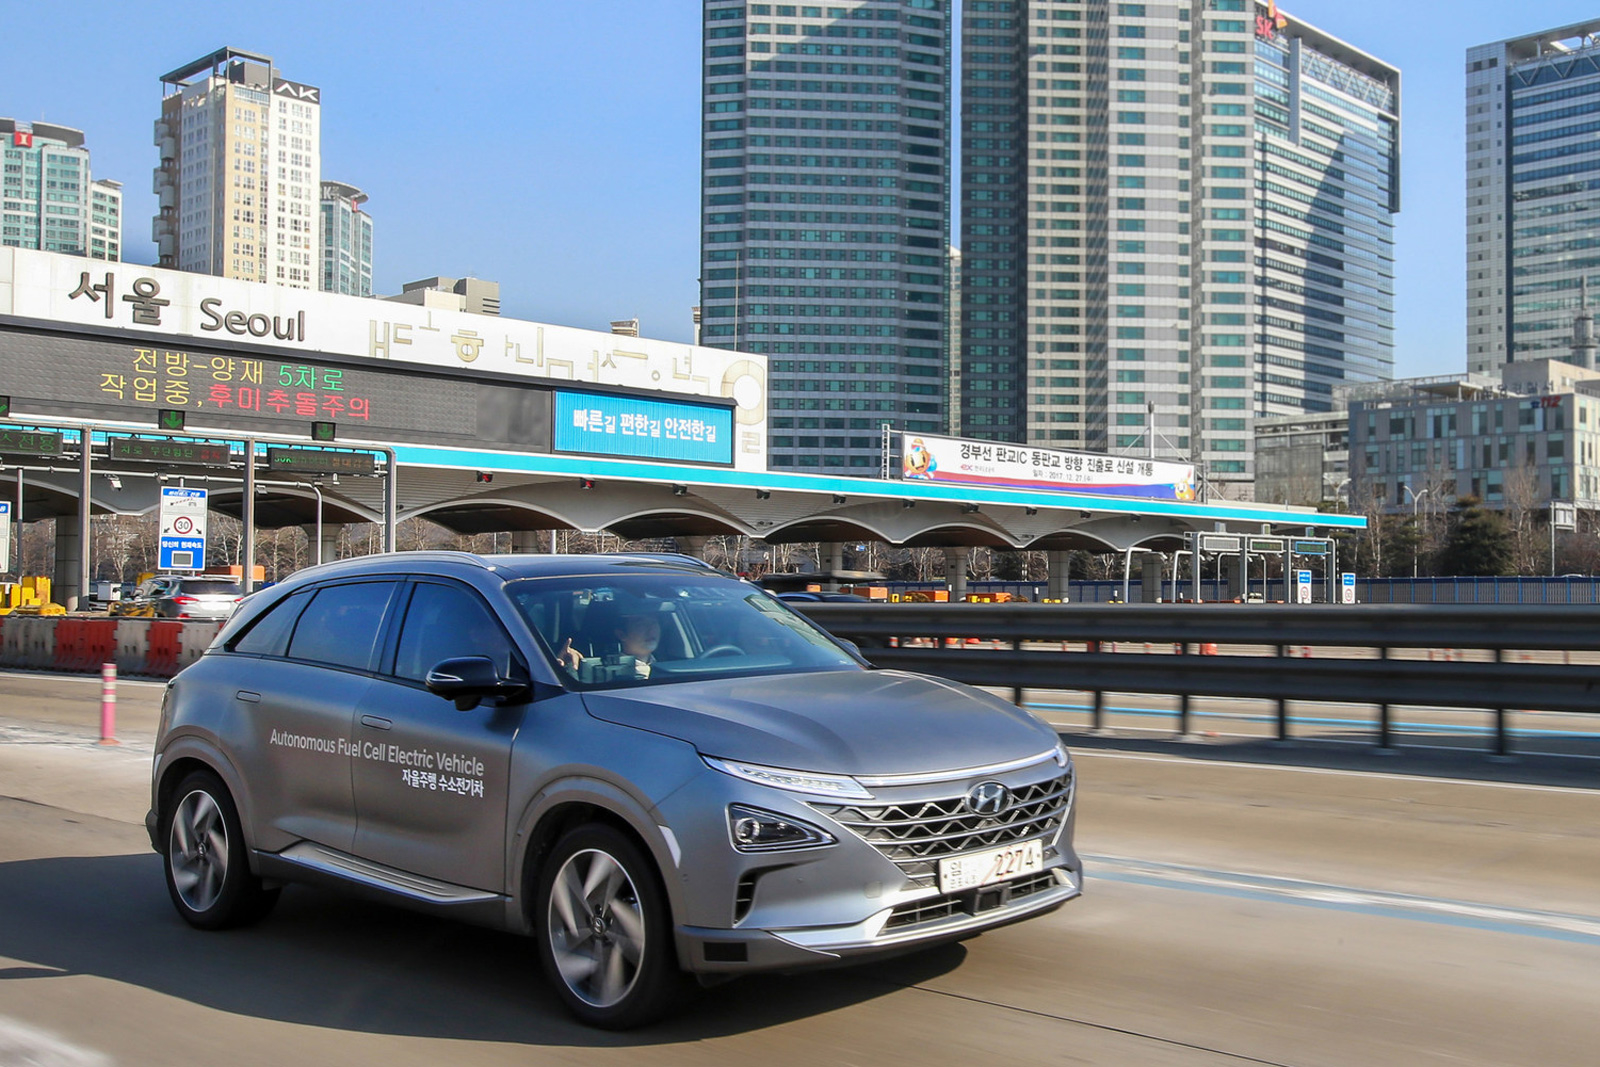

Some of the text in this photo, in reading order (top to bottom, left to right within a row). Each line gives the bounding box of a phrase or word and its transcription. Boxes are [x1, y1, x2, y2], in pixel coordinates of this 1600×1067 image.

[1255, 15, 1274, 40] SK
[68, 271, 171, 327] 서울
[200, 298, 305, 342] Seoul
[133, 347, 345, 392] 전방-양재 5차로
[573, 408, 716, 443] 빠른길 편한길 안전한길
[960, 444, 1154, 477] 경부선 판교IC 동판교 방향 진출로 신설 개통
[177, 521, 189, 530] 30
[270, 729, 485, 777] Autonomous Fuel Cell Electric Vehicle
[402, 769, 485, 798] 자율주행 수소전기차
[994, 847, 1035, 876] 2274
